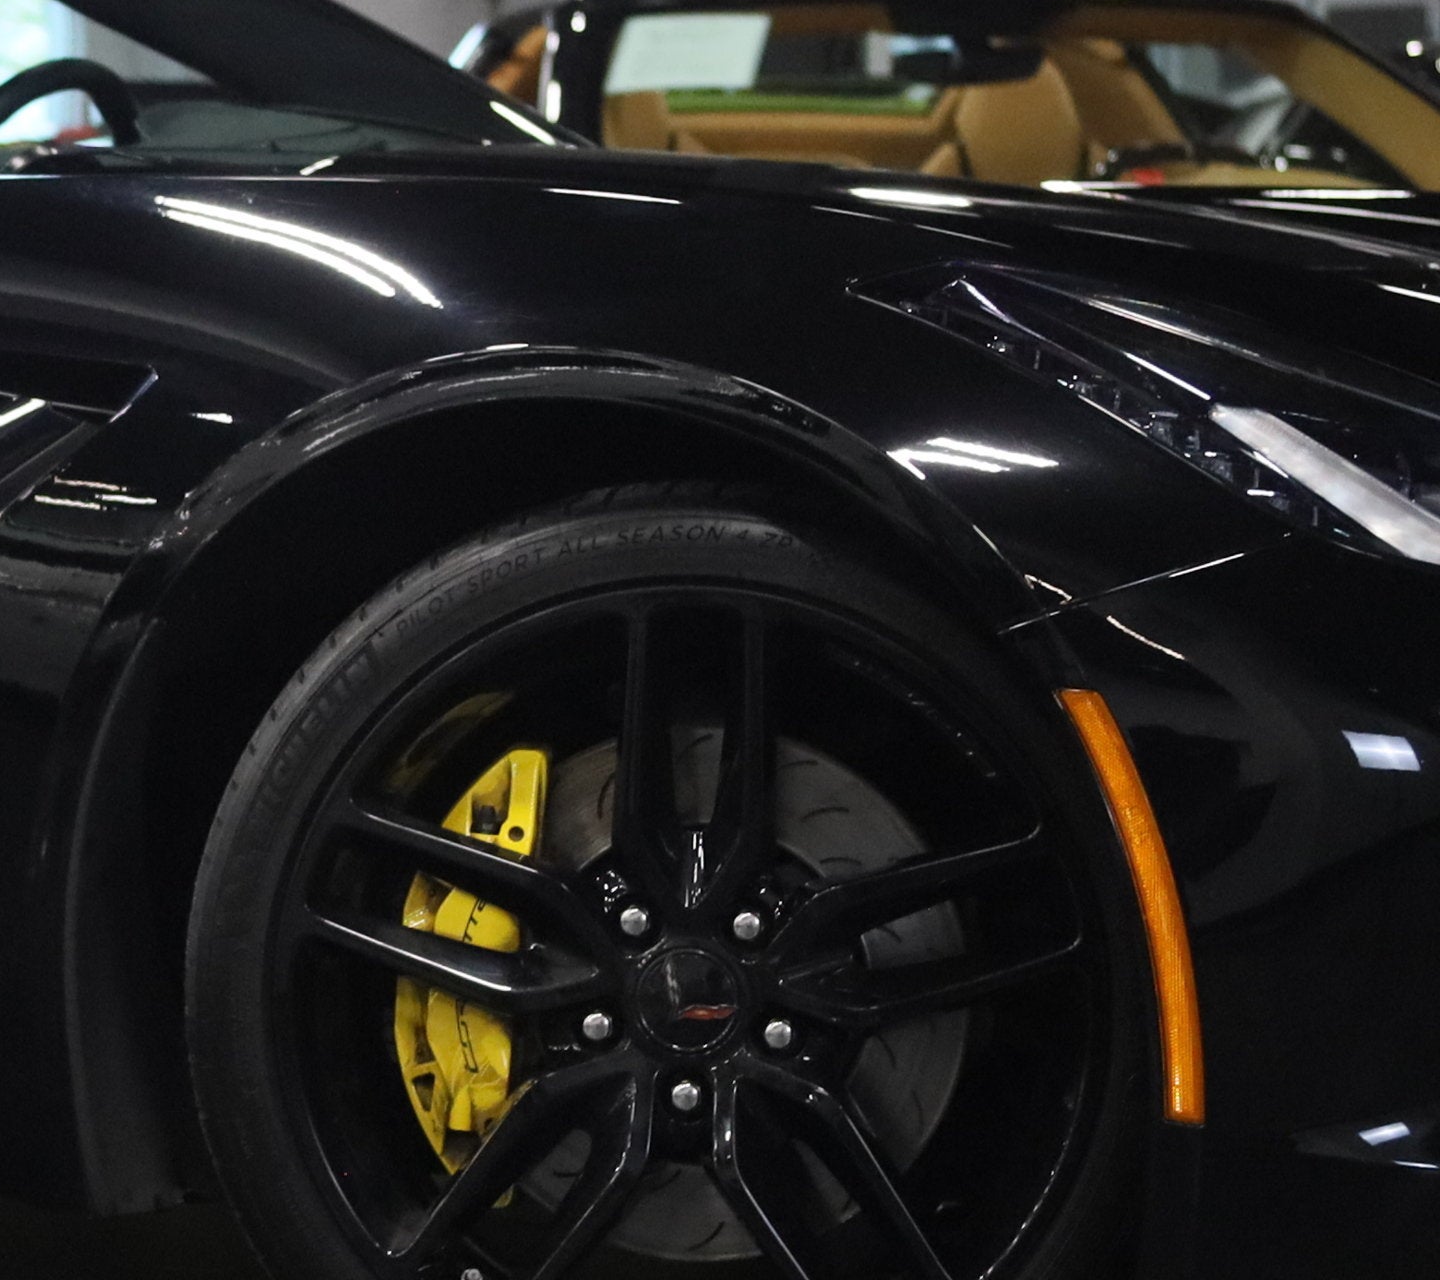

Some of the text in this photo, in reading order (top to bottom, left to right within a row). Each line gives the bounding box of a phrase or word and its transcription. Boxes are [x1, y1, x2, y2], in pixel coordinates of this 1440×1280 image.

[394, 592, 455, 633] PILOT
[466, 546, 546, 594] SPORT
[558, 536, 601, 558] ALL
[617, 525, 725, 546] SEASON
